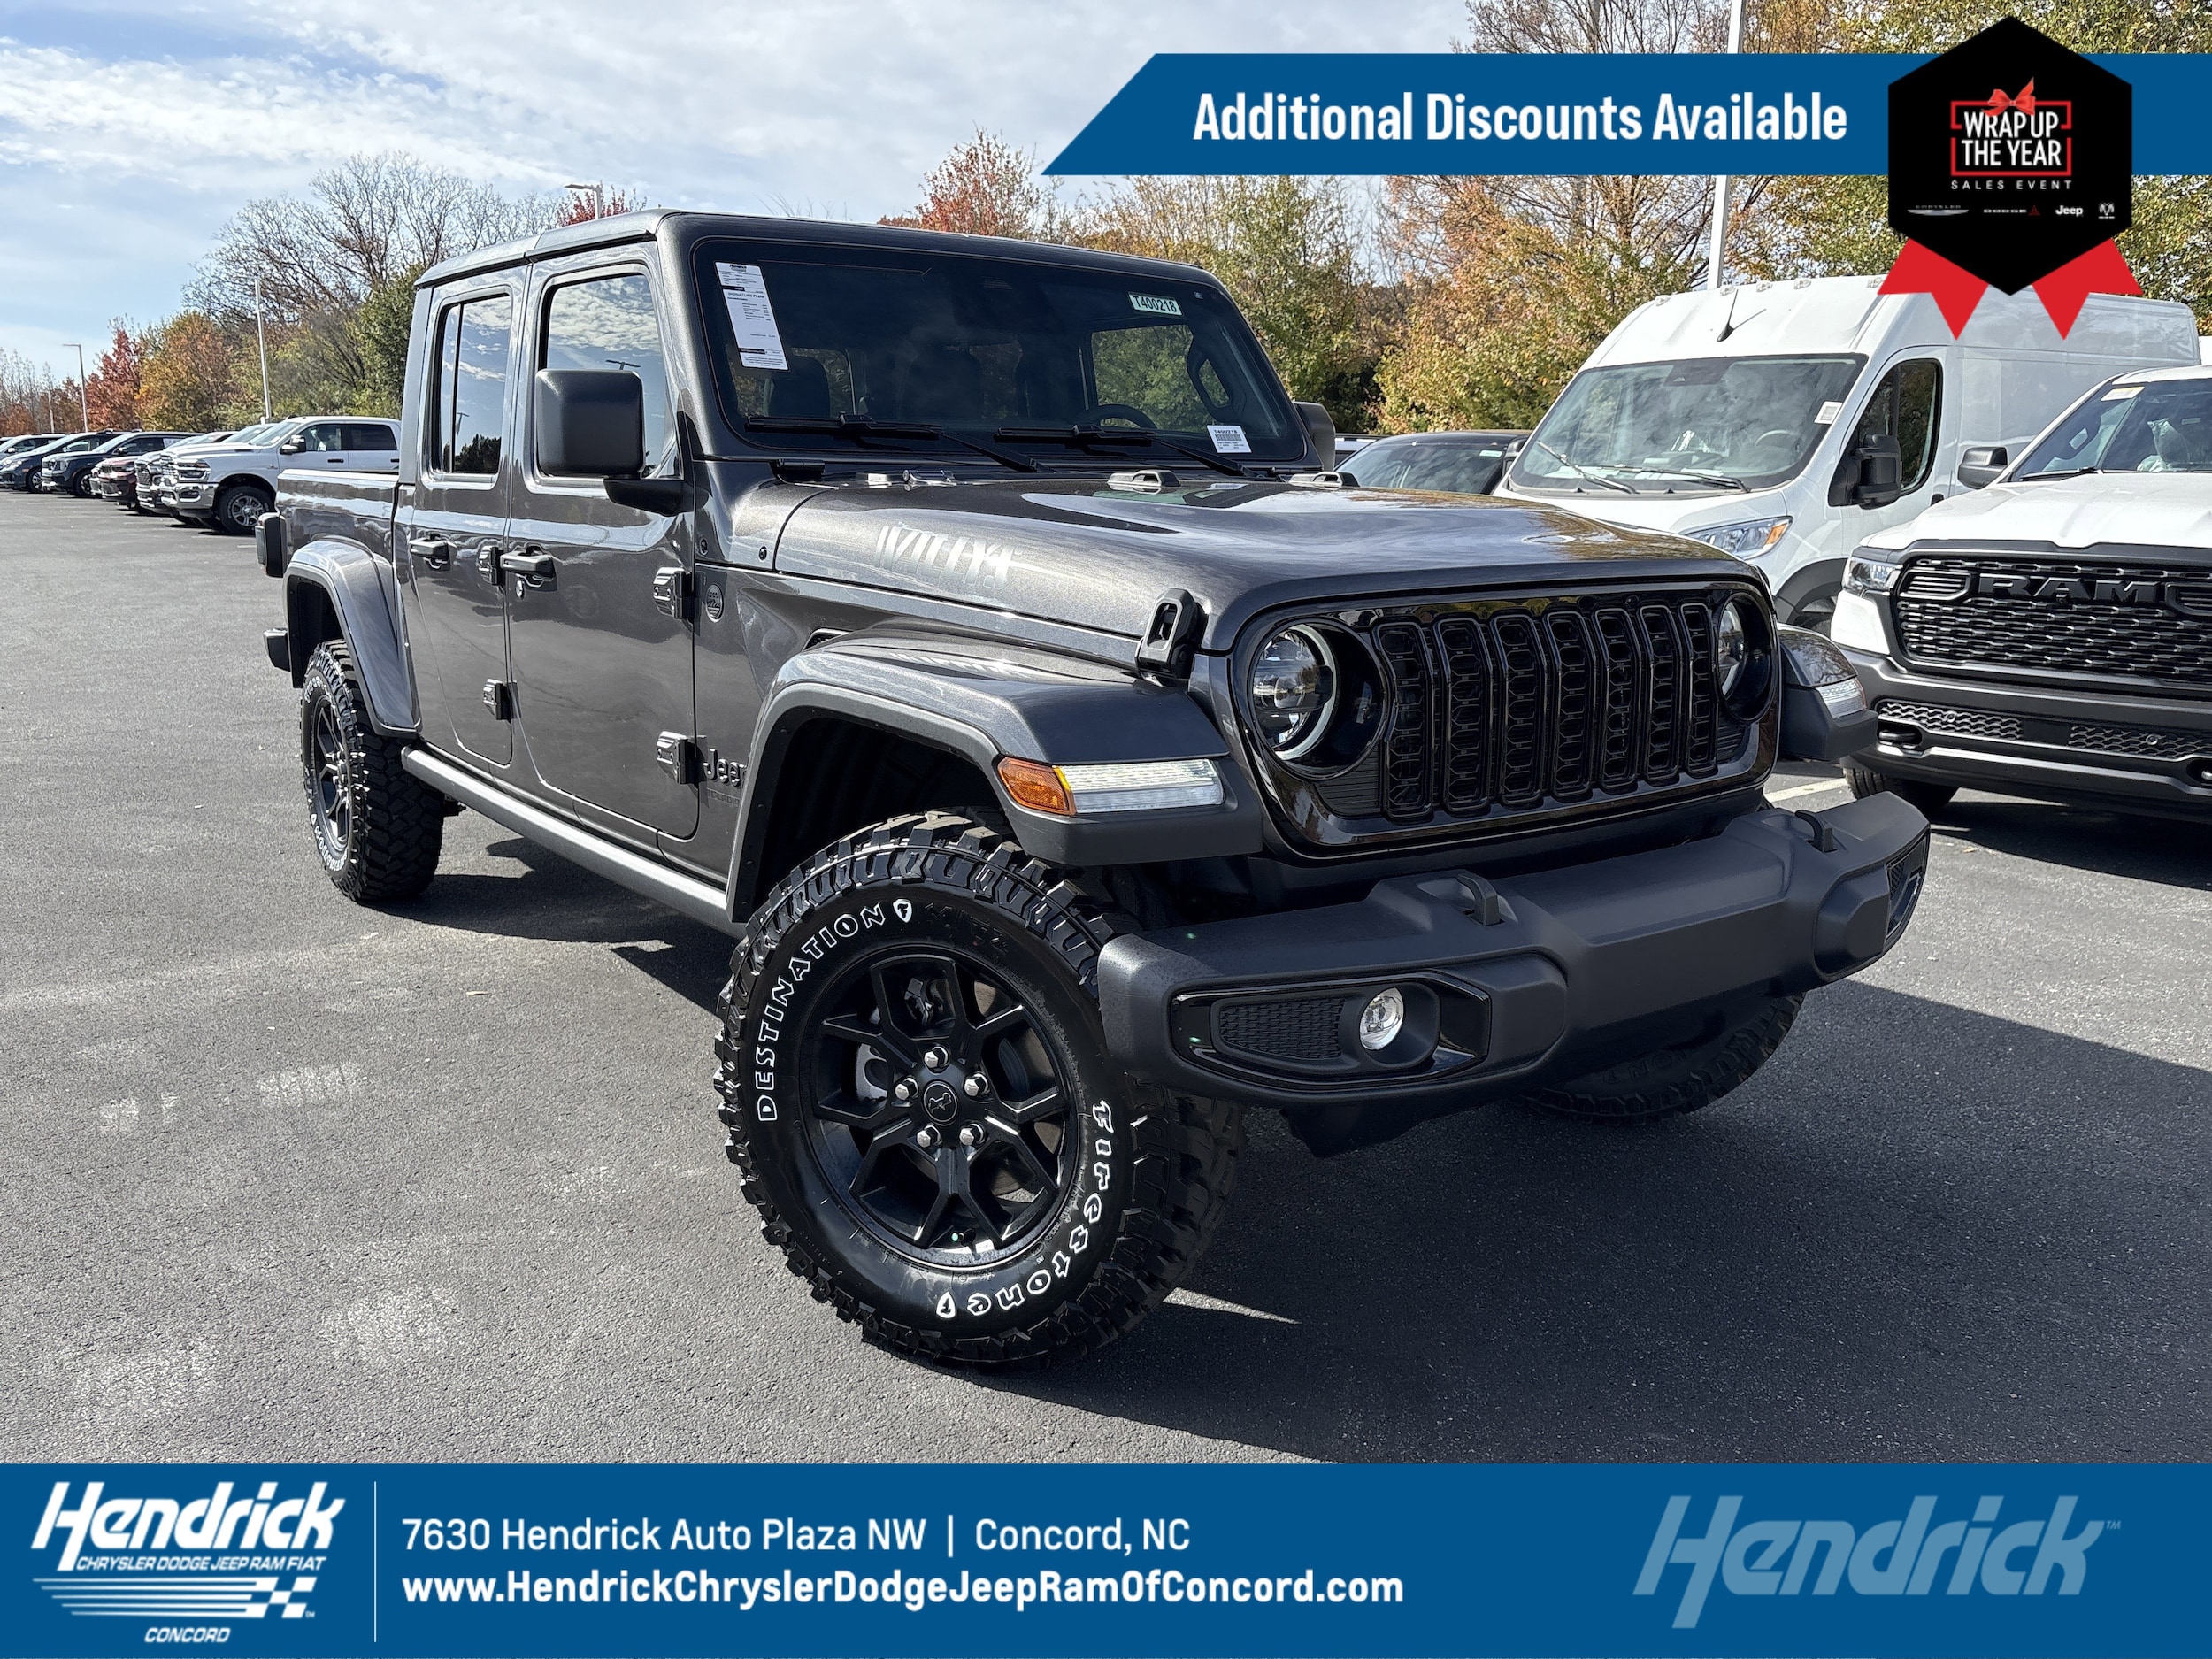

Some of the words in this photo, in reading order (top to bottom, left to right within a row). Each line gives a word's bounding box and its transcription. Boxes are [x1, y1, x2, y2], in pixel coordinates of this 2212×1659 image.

[1132, 295, 1178, 313] T400218
[1978, 572, 2161, 603] RAM
[757, 901, 886, 1122] DESTINATION
[965, 1099, 1114, 1318] Firestone
